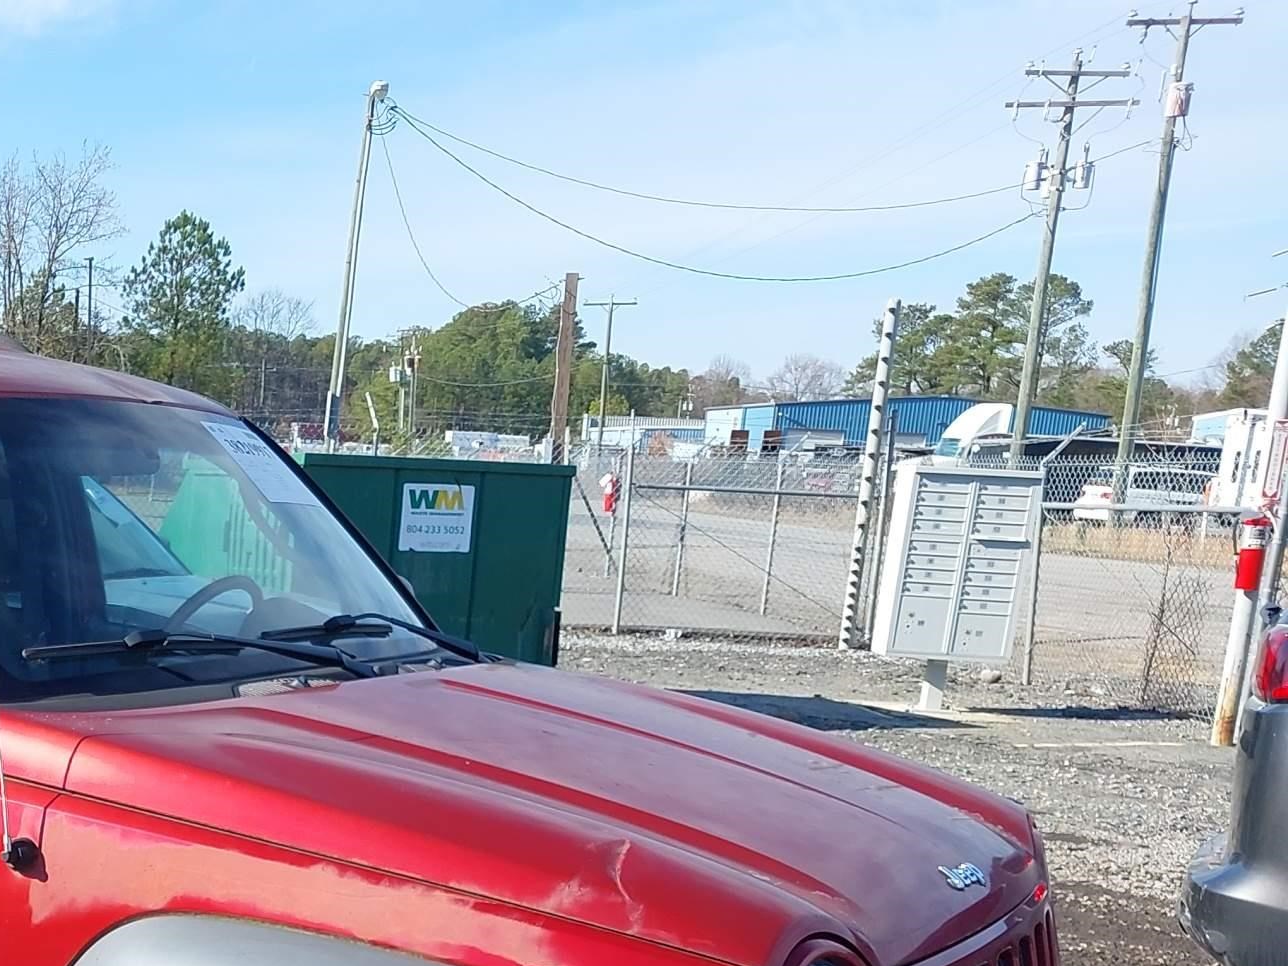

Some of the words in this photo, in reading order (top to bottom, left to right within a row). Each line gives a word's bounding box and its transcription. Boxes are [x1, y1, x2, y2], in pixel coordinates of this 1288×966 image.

[409, 489, 464, 511] WM
[406, 525, 423, 534] 804
[424, 525, 442, 535] 233
[443, 526, 465, 535] 5052
